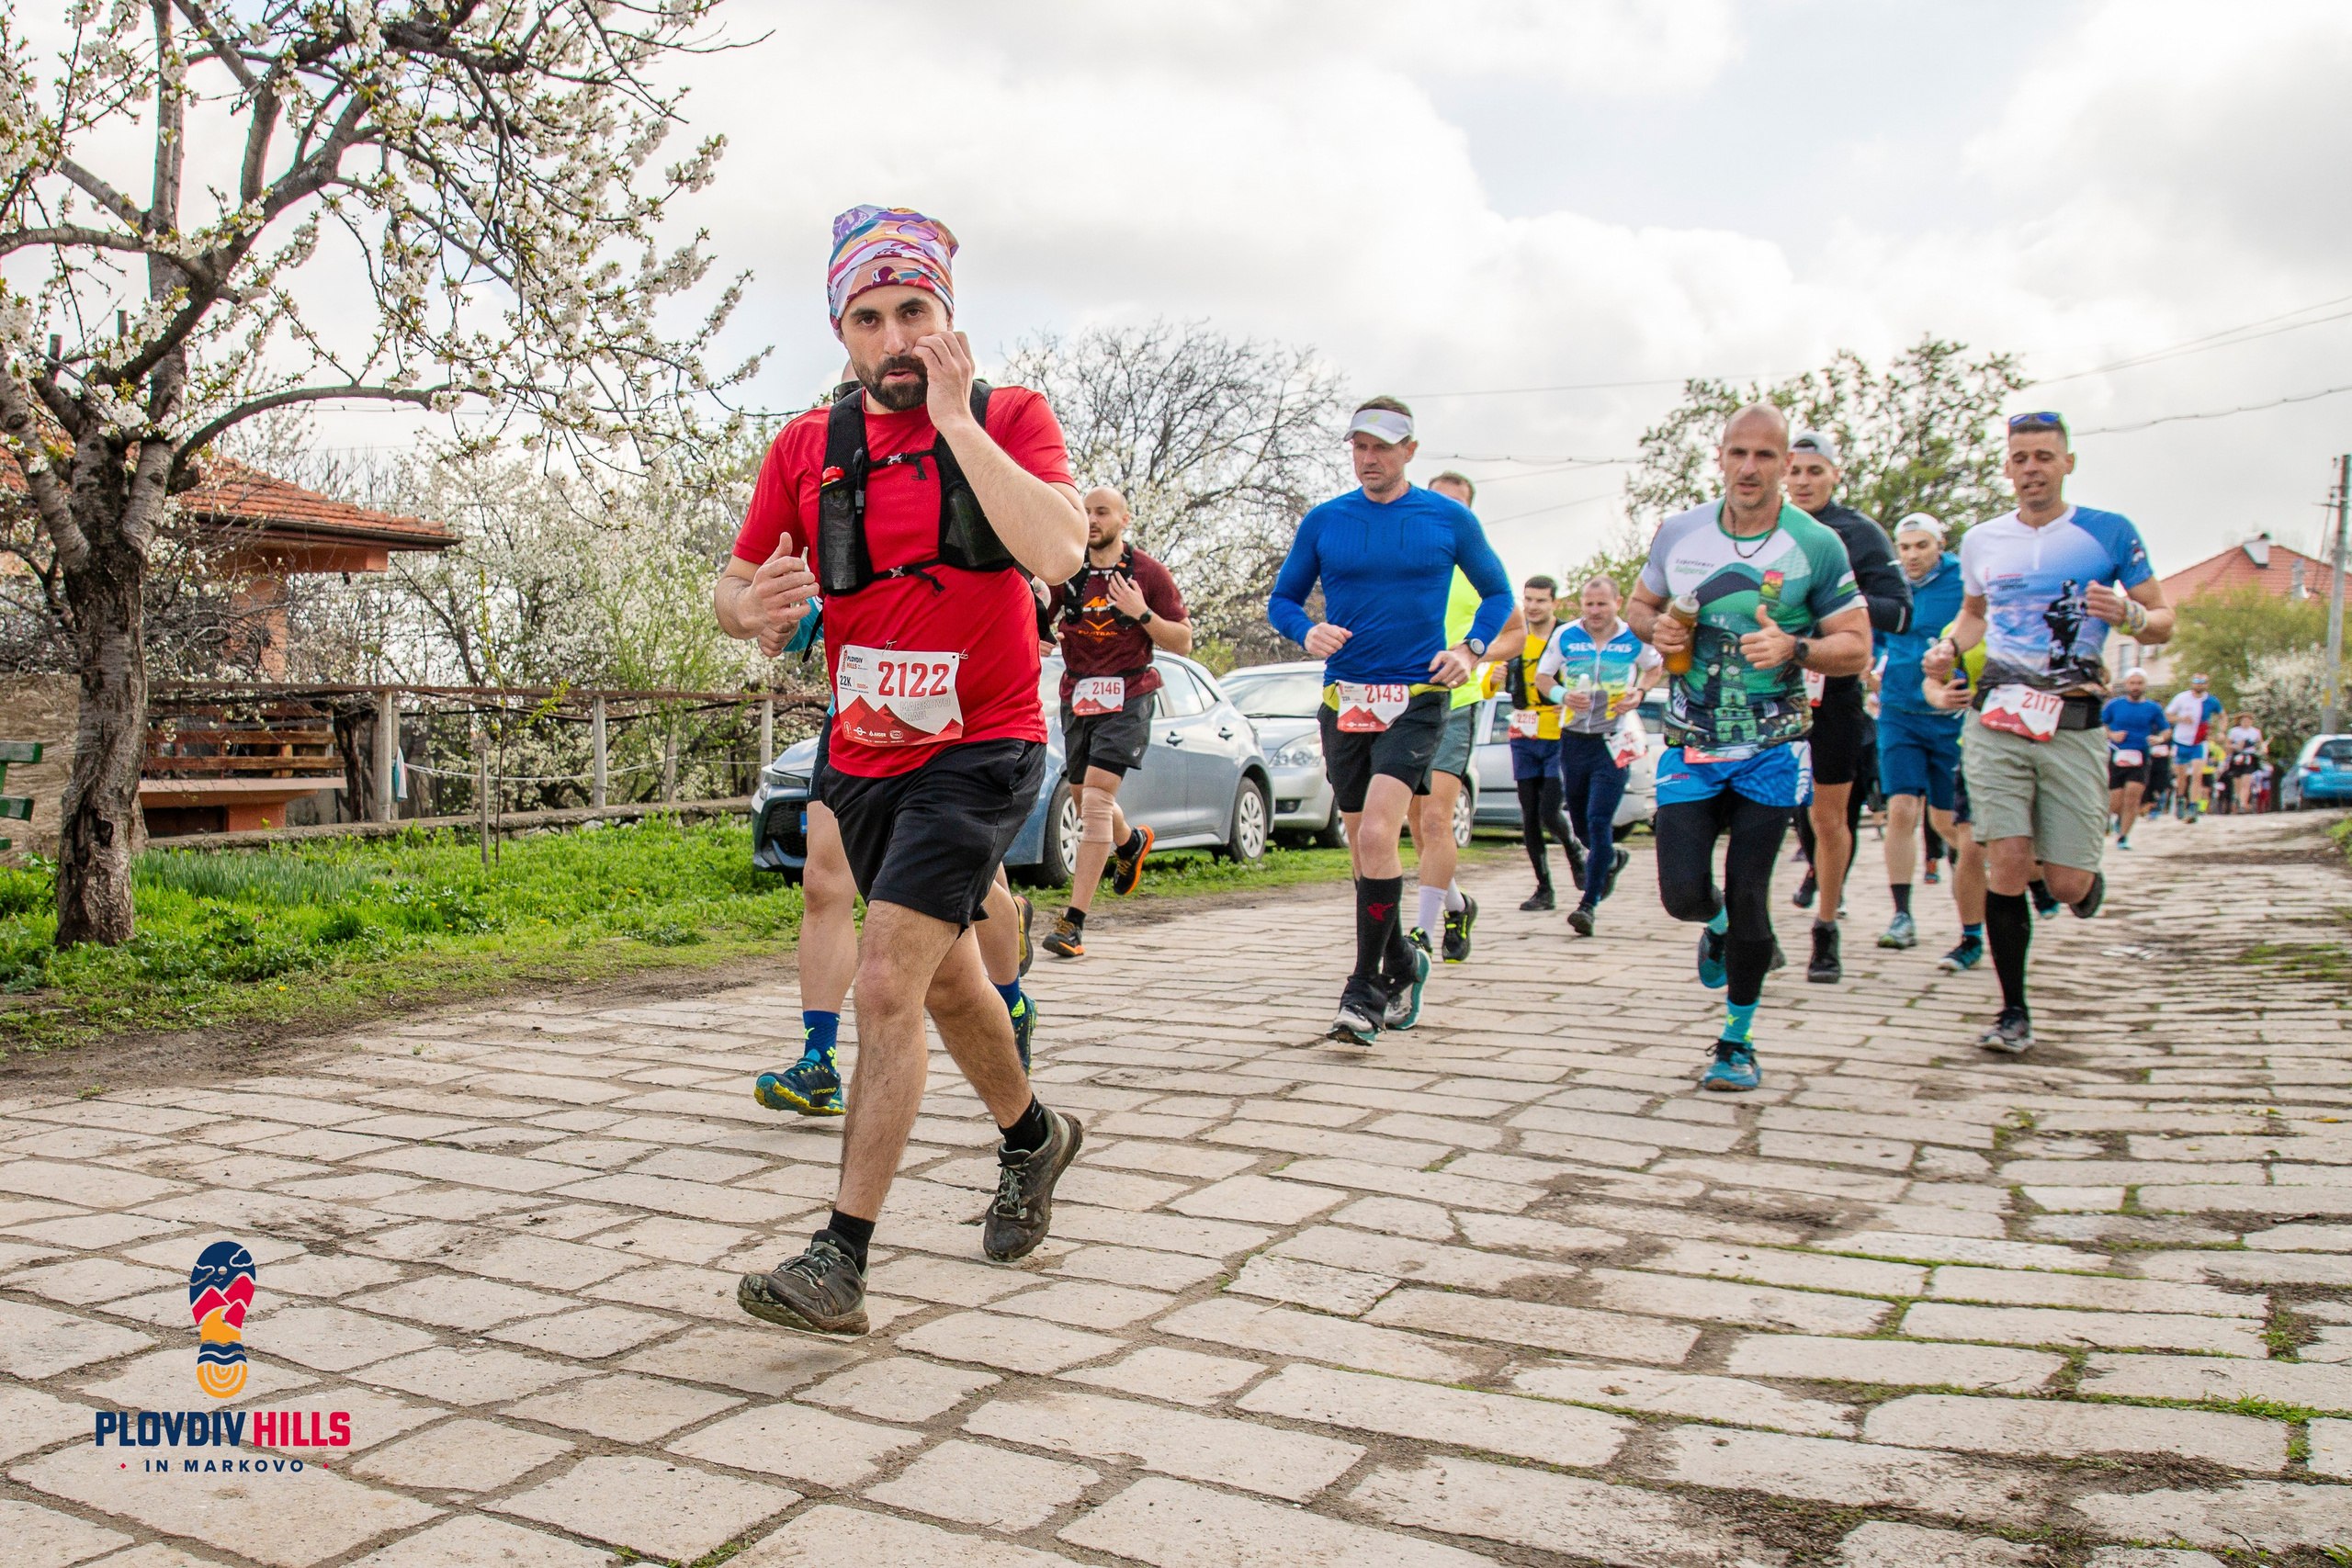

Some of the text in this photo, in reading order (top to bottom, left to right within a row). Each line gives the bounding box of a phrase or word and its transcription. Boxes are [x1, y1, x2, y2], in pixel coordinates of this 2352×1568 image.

[846, 655, 864, 664] PLOVDIV
[840, 675, 852, 687] 22K
[877, 660, 950, 698] 2122
[1092, 682, 1121, 695] 2146
[1364, 683, 1404, 704] 2143
[899, 697, 951, 711] MARKOVO
[2021, 692, 2060, 715] 2117
[899, 710, 929, 722] TRAIL
